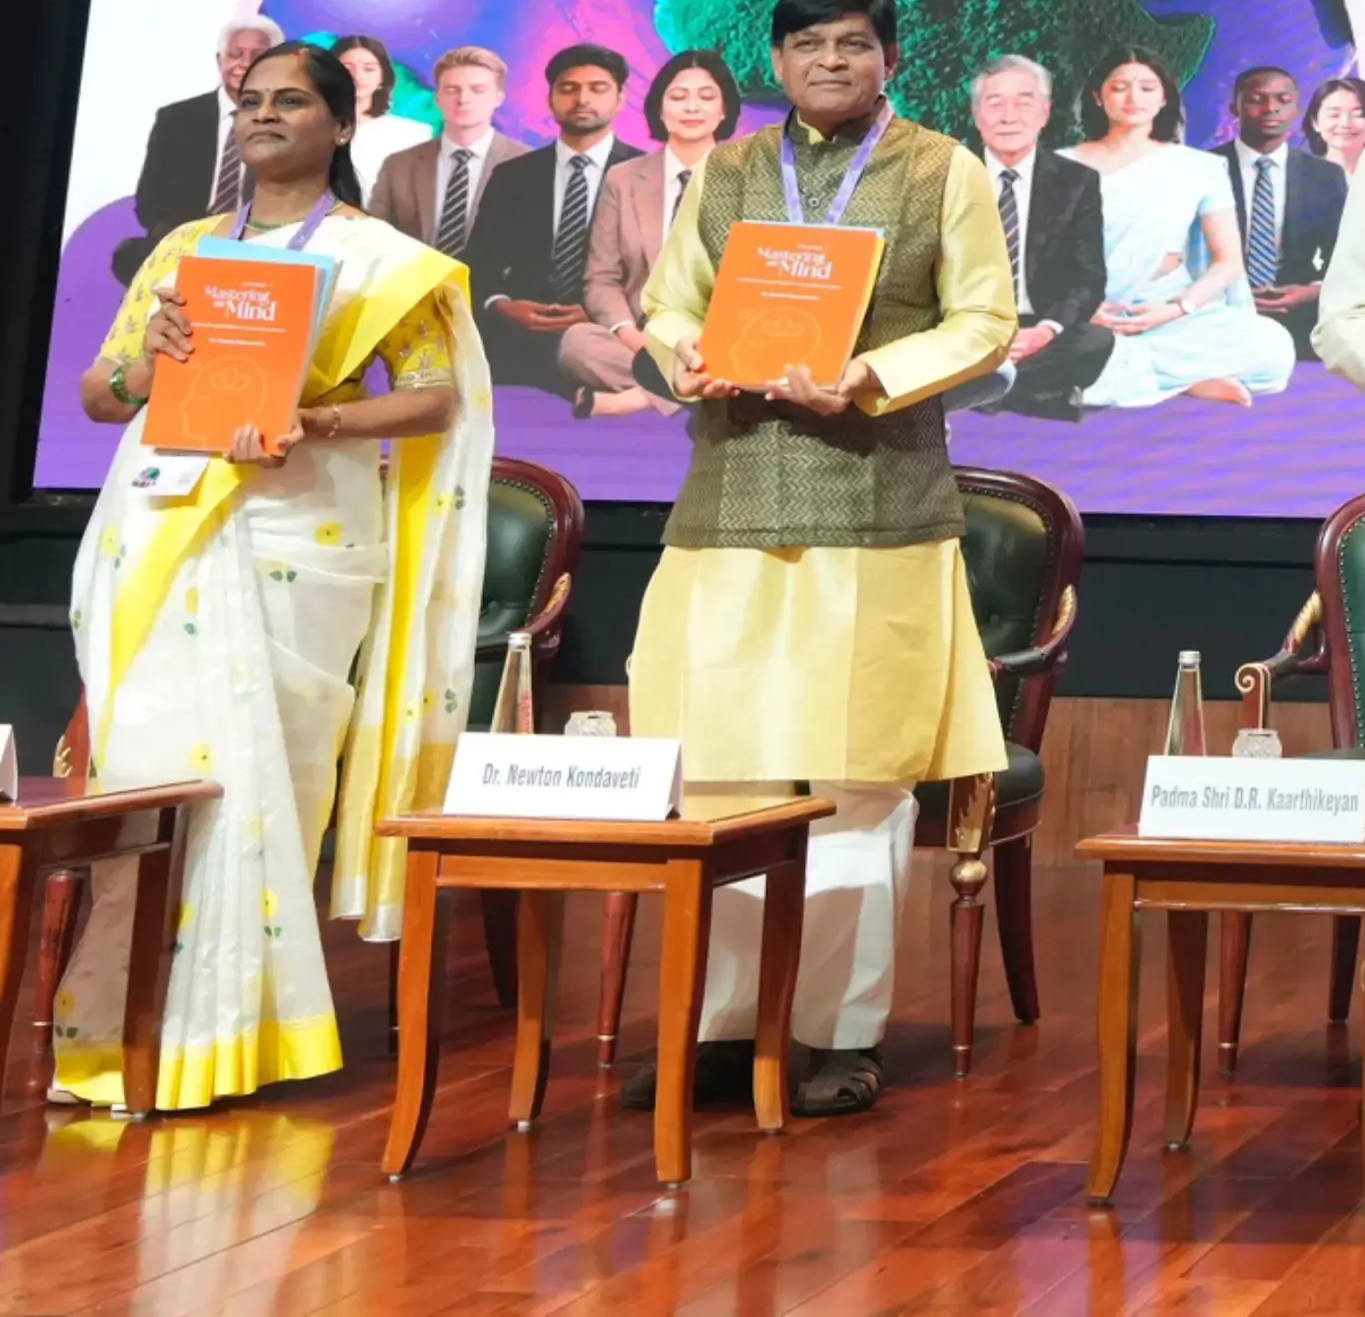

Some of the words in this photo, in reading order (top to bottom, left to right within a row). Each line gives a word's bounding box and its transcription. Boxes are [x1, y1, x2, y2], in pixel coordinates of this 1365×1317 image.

[777, 261, 833, 280] Mind
[224, 300, 277, 322] Mind
[482, 762, 501, 786] Dr.
[506, 763, 562, 787] Newton
[566, 764, 642, 790] Kondaveti
[1151, 784, 1198, 809] Padma
[1202, 785, 1231, 810] Shri
[1266, 787, 1360, 817] Kaarthikeyan
